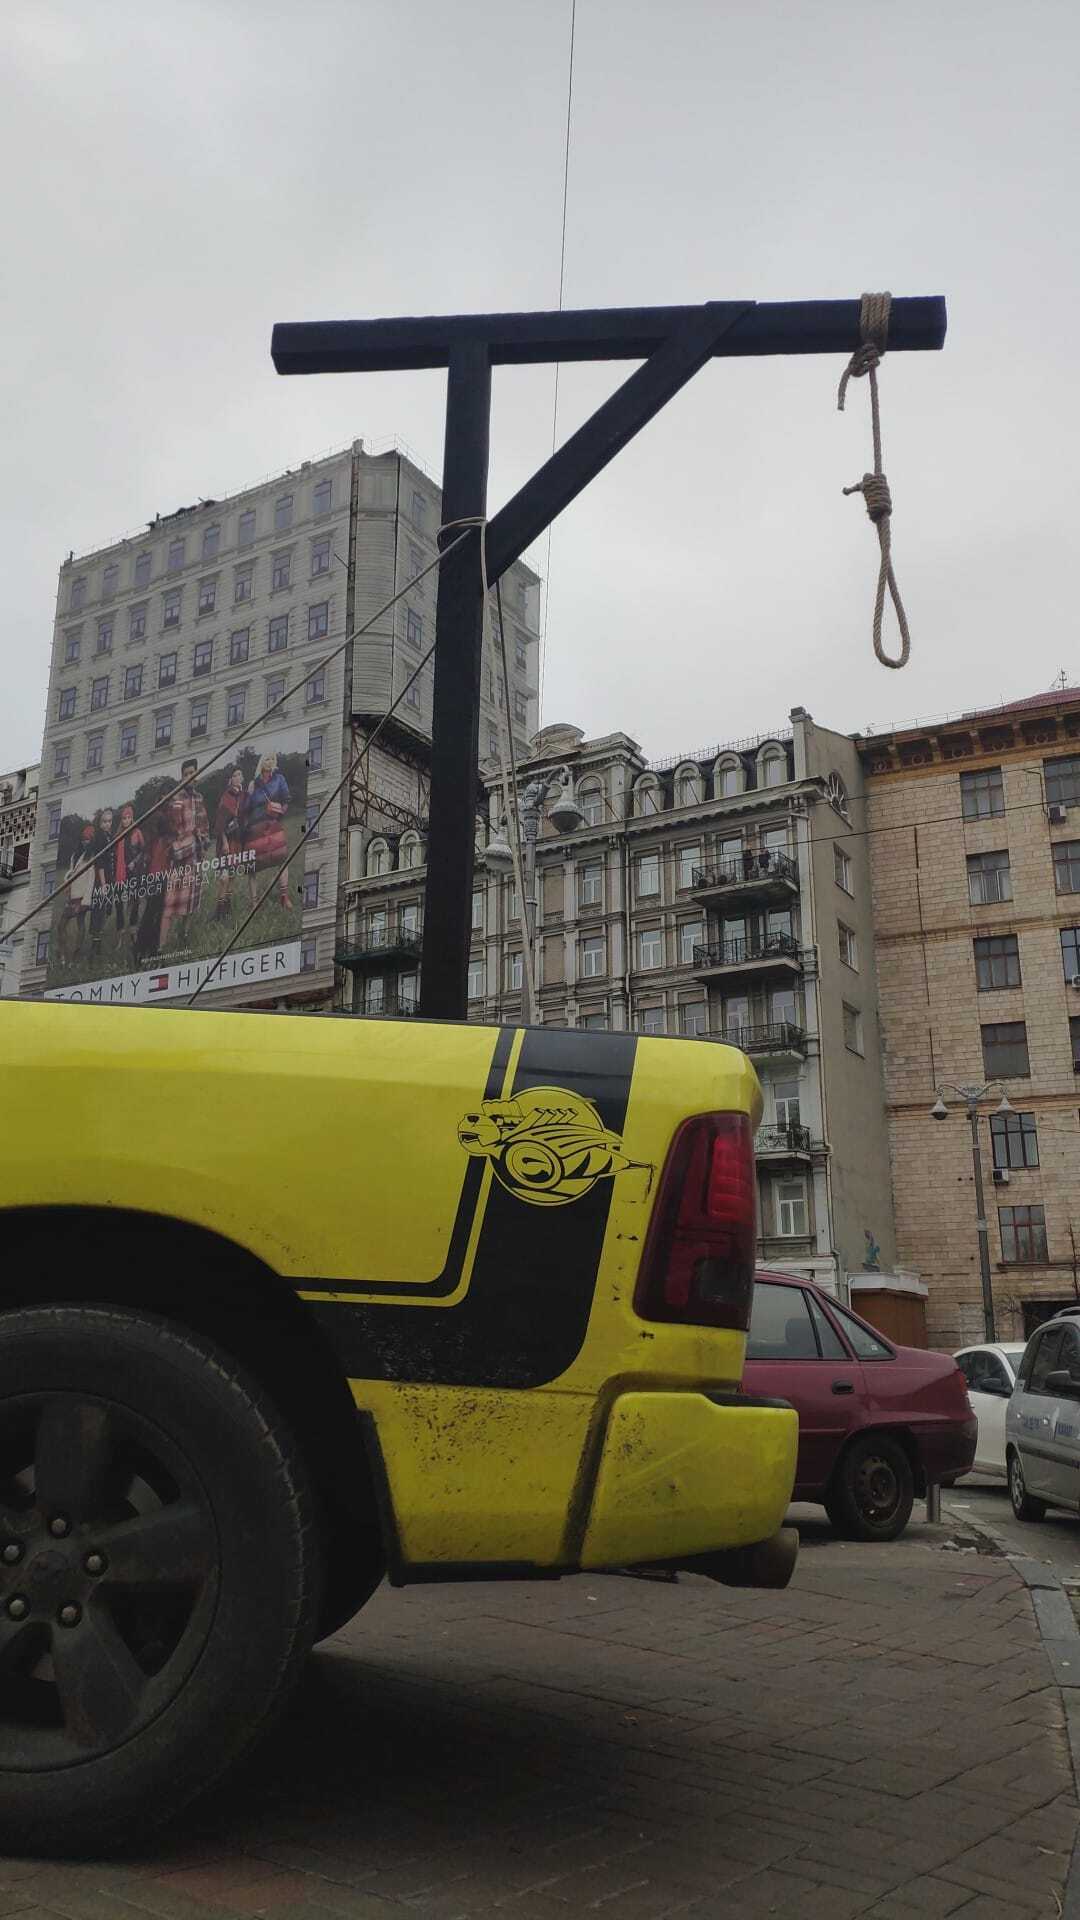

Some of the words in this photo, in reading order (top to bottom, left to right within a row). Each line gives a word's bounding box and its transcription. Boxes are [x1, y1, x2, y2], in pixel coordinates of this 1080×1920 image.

[92, 882, 163, 907] РУХАЄМОСЯ
[166, 873, 211, 893] ВПЕРЕД
[214, 861, 257, 882] РАЗОМ
[93, 876, 138, 897] MOVING
[140, 864, 192, 885] FORWARD
[195, 849, 257, 873] TOGETHER
[178, 951, 287, 989] HILFIGER
